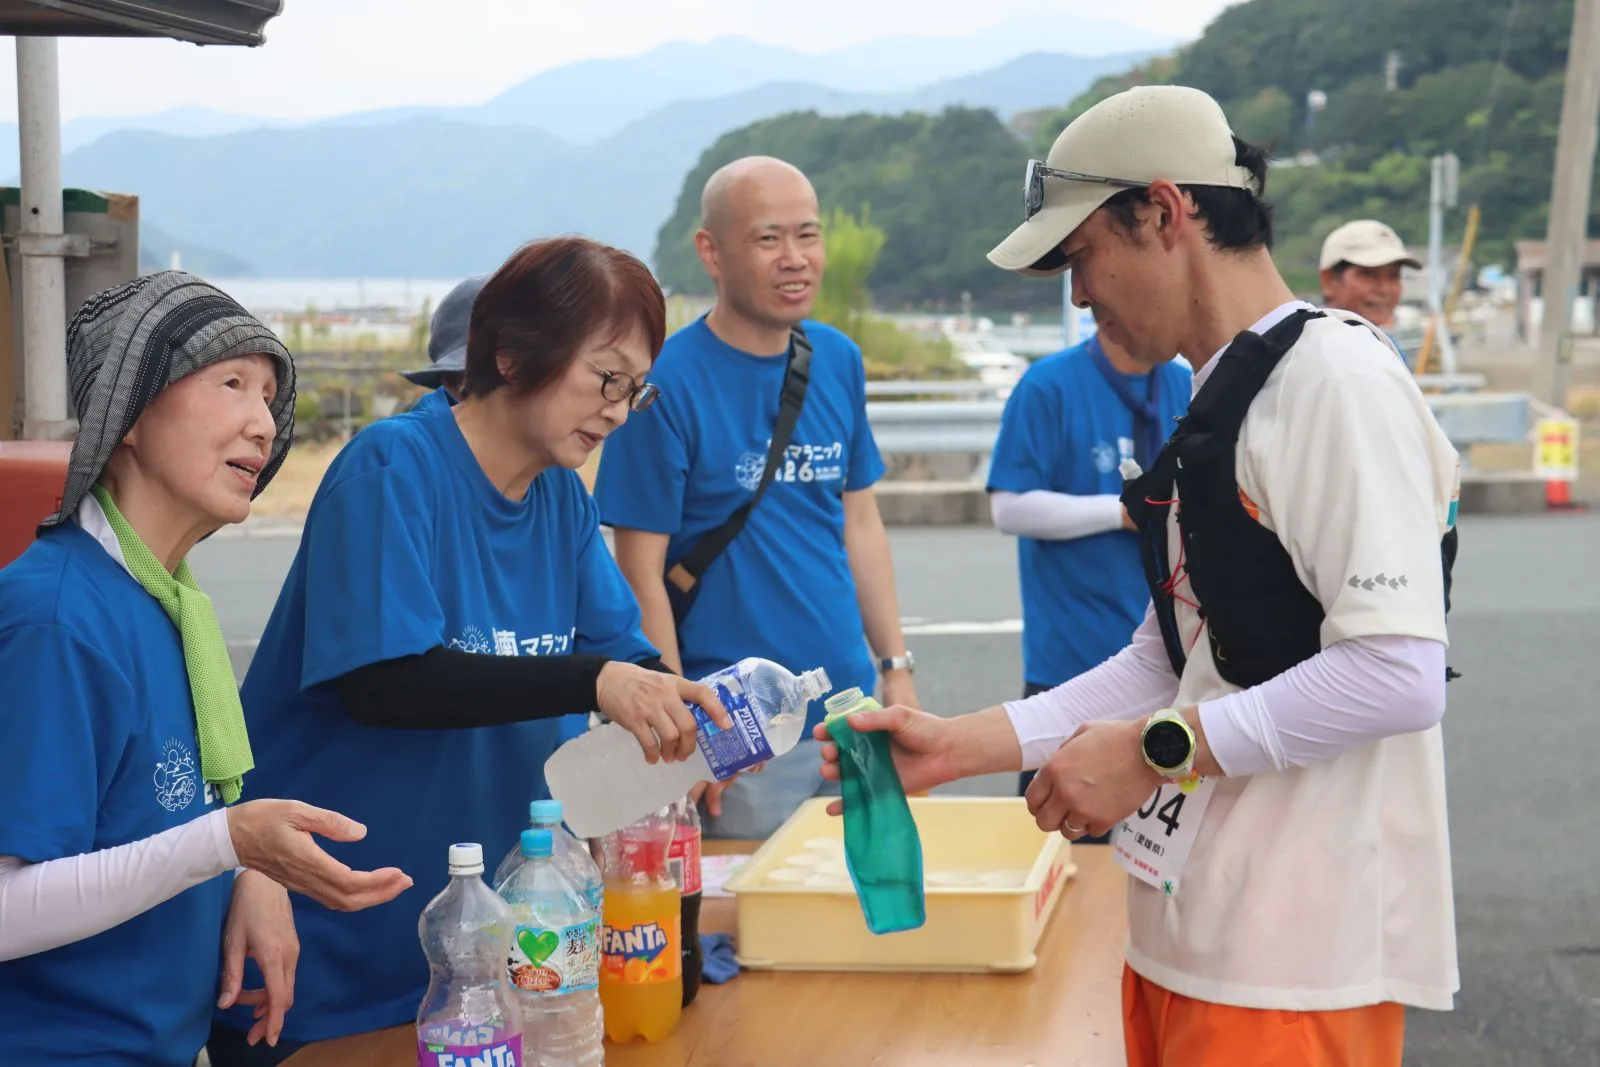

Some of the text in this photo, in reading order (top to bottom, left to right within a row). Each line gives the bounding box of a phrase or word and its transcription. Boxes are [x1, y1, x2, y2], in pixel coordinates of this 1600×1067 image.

[767, 439, 842, 461] マラニック
[775, 460, 814, 482] 26
[602, 923, 667, 955] FANTA
